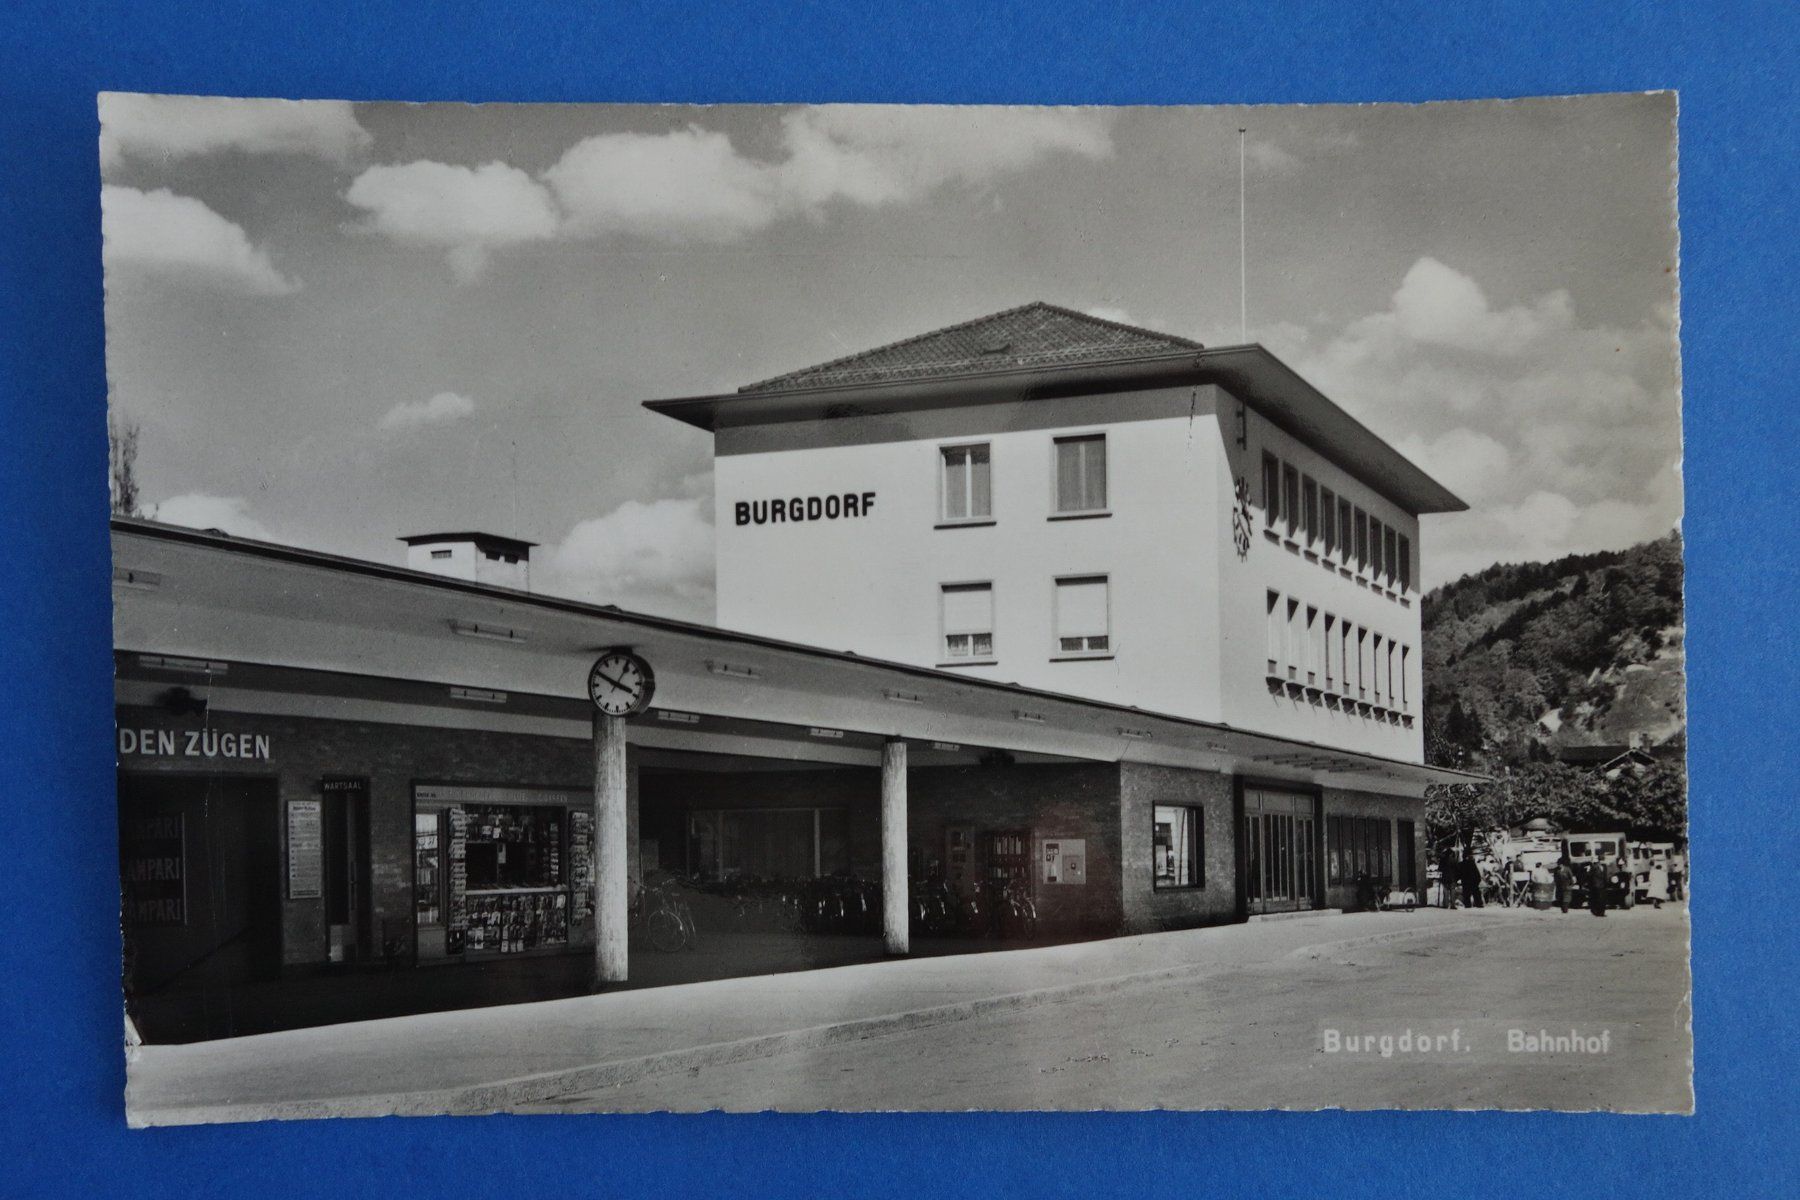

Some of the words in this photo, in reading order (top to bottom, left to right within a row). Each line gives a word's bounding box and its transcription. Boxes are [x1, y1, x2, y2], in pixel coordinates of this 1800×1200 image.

[735, 492, 876, 526] BURGDORF
[119, 728, 174, 755] DEN
[184, 728, 270, 758] ZÜGEN
[323, 781, 362, 791] WARTSAAL
[127, 857, 180, 881] AMPARI
